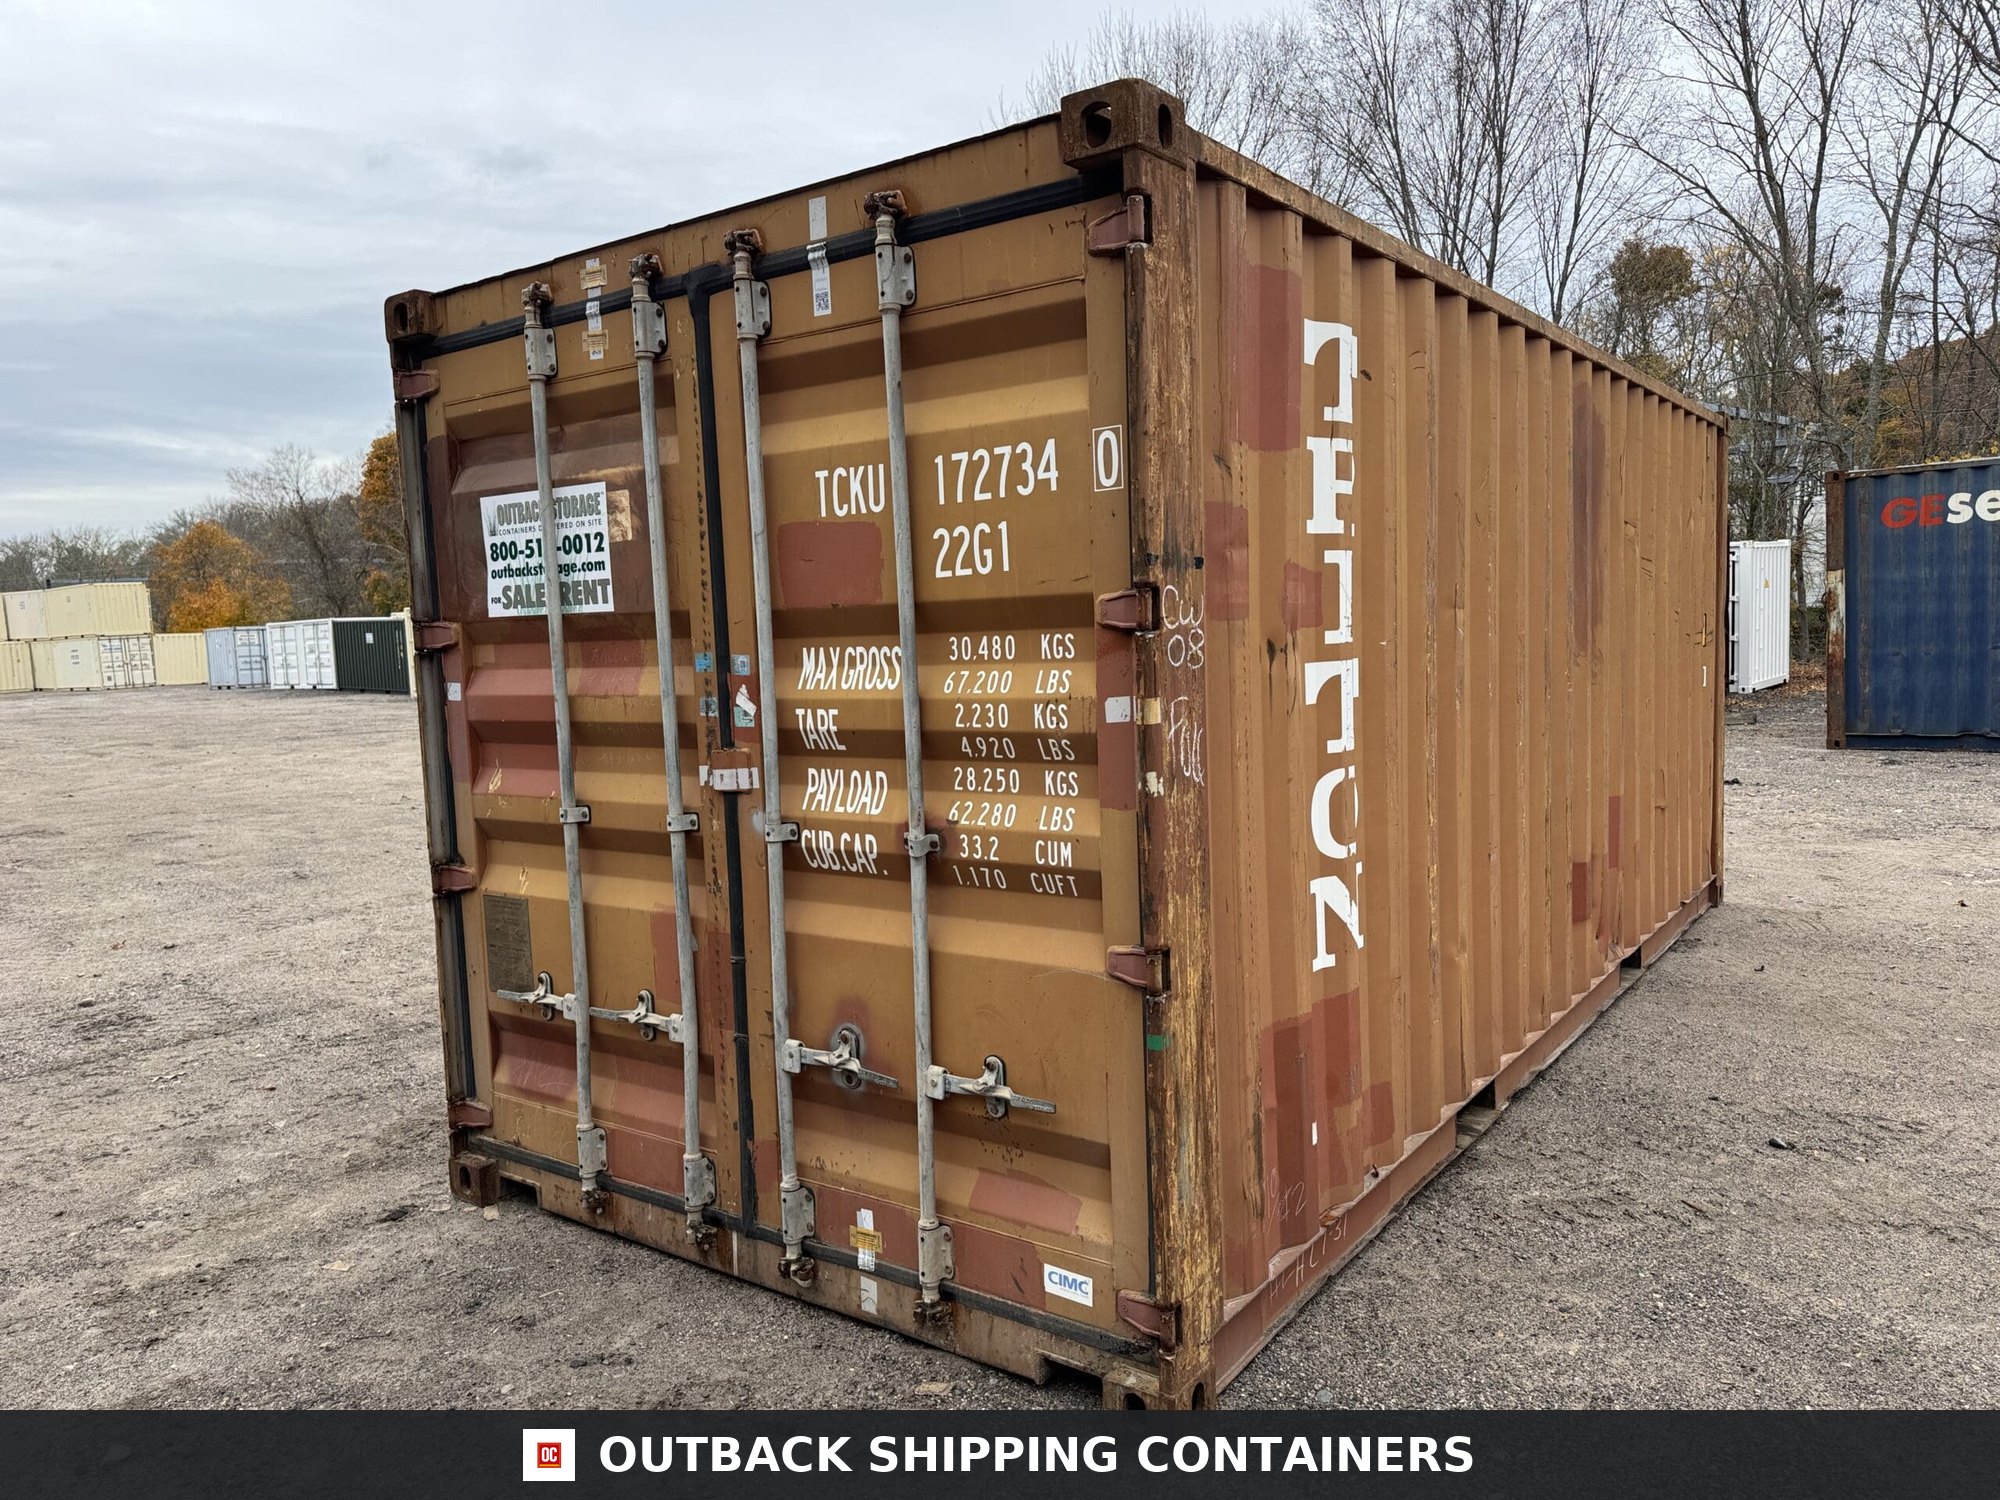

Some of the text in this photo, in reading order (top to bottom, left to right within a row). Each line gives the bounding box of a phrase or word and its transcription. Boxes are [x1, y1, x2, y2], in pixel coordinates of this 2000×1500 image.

[815, 430, 1119, 517] TCKU 172734 0
[496, 500, 542, 527] OUTBAC
[498, 525, 536, 537] CONTAINERS
[575, 519, 586, 529] ON
[588, 518, 603, 527] SITE
[490, 532, 605, 562] 800-51-0012
[932, 520, 1010, 578] 22G1
[490, 560, 606, 580] outbackstage.com
[491, 578, 611, 611] FOR SALE RENT
[797, 646, 840, 690] MAX
[841, 645, 902, 690] GROSS
[1041, 633, 1075, 660] KGS
[1035, 669, 1072, 694] LBS
[795, 708, 847, 750] TARE
[1034, 703, 1068, 729] KGS
[1037, 738, 1075, 761] LBS
[802, 767, 888, 815] PAYLOAD
[1045, 770, 1079, 797] KGS
[1039, 805, 1075, 832] LBS
[959, 834, 999, 861] 33.2
[1035, 840, 1072, 867] CUM
[1030, 872, 1079, 897] CUFT
[1047, 1270, 1089, 1296] CIMC
